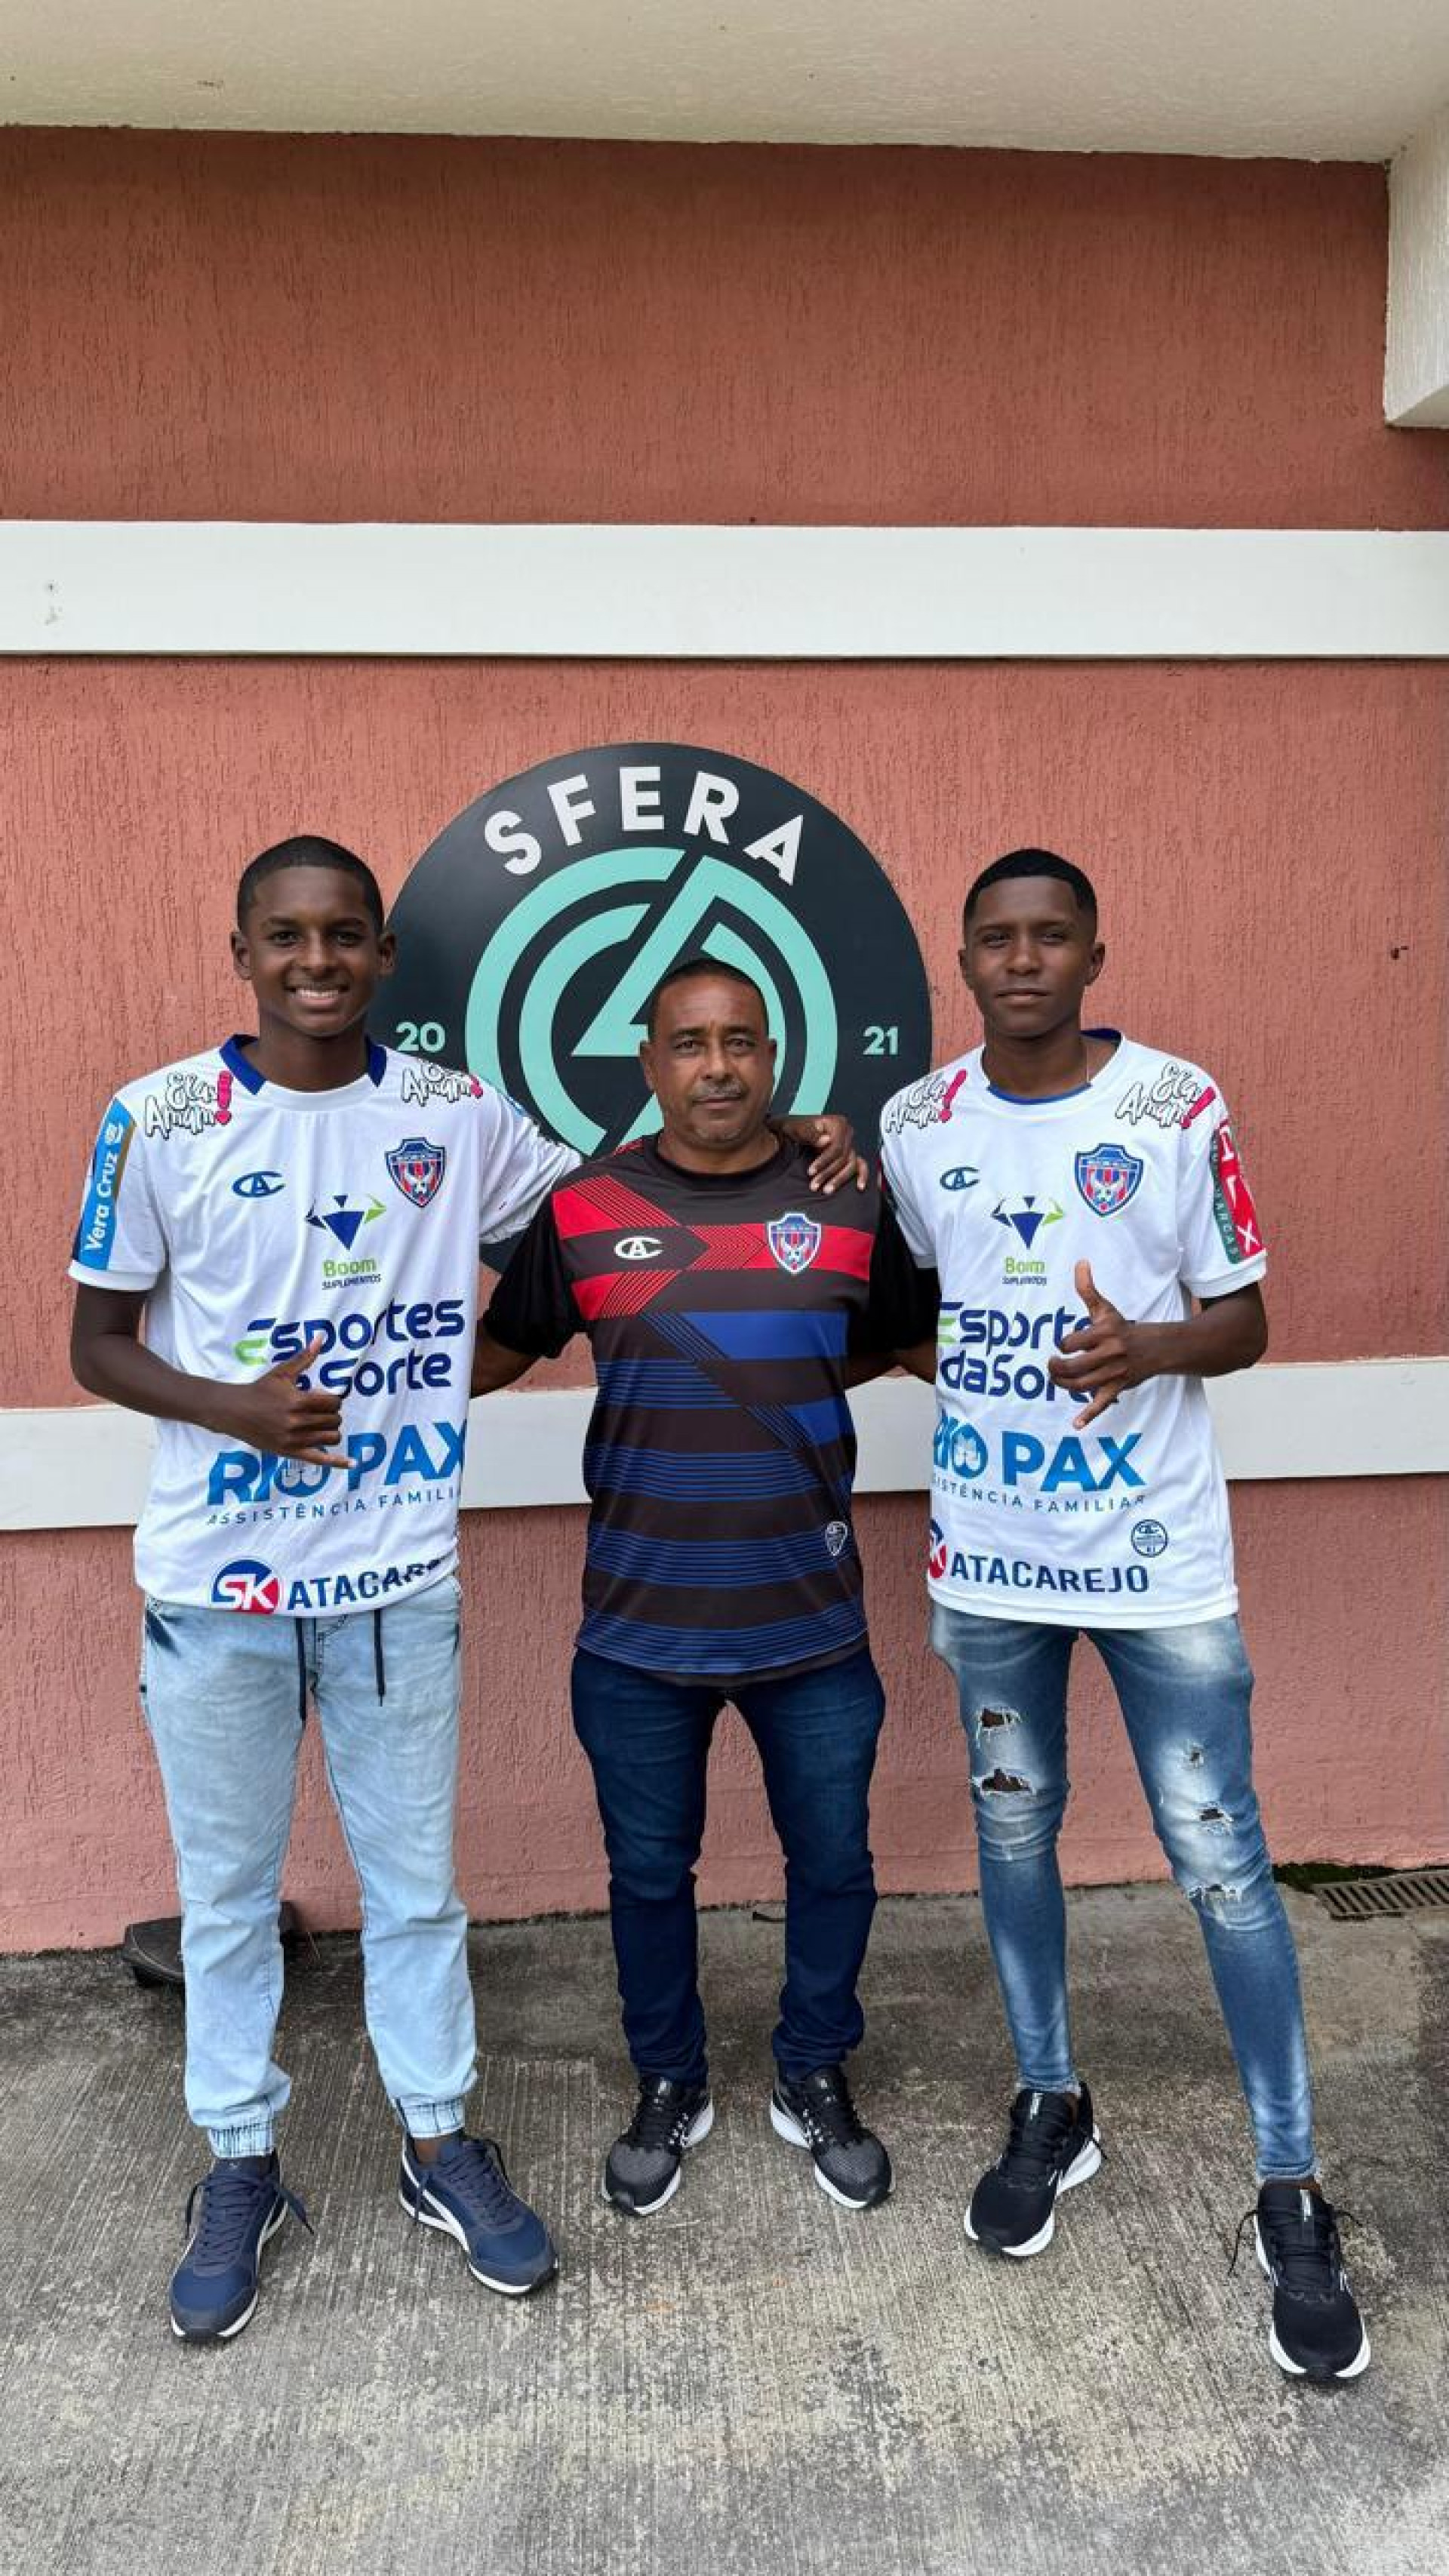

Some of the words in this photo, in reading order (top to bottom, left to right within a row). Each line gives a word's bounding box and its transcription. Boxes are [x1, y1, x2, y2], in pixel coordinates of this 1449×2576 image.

[484, 766, 804, 885] SFERA
[395, 1022, 446, 1053] 20
[863, 1026, 898, 1056] 21
[96, 1151, 118, 1198] Cruz
[85, 1205, 109, 1250] Vera
[323, 1259, 377, 1278] Boom
[938, 1302, 1135, 1356] Esport
[296, 1349, 452, 1399] Sorte
[940, 1350, 1118, 1403] daSo
[348, 1419, 467, 1492] PAX
[1002, 1431, 1146, 1491] PAX
[380, 1487, 454, 1508] FAMILI
[936, 1477, 1023, 1508] ISTÊNCIA
[1035, 1495, 1145, 1512] FAMILIAR
[211, 1568, 278, 1613] SK
[288, 1559, 441, 1610] ATACAR
[950, 1551, 1149, 1593] ATACAREJO
